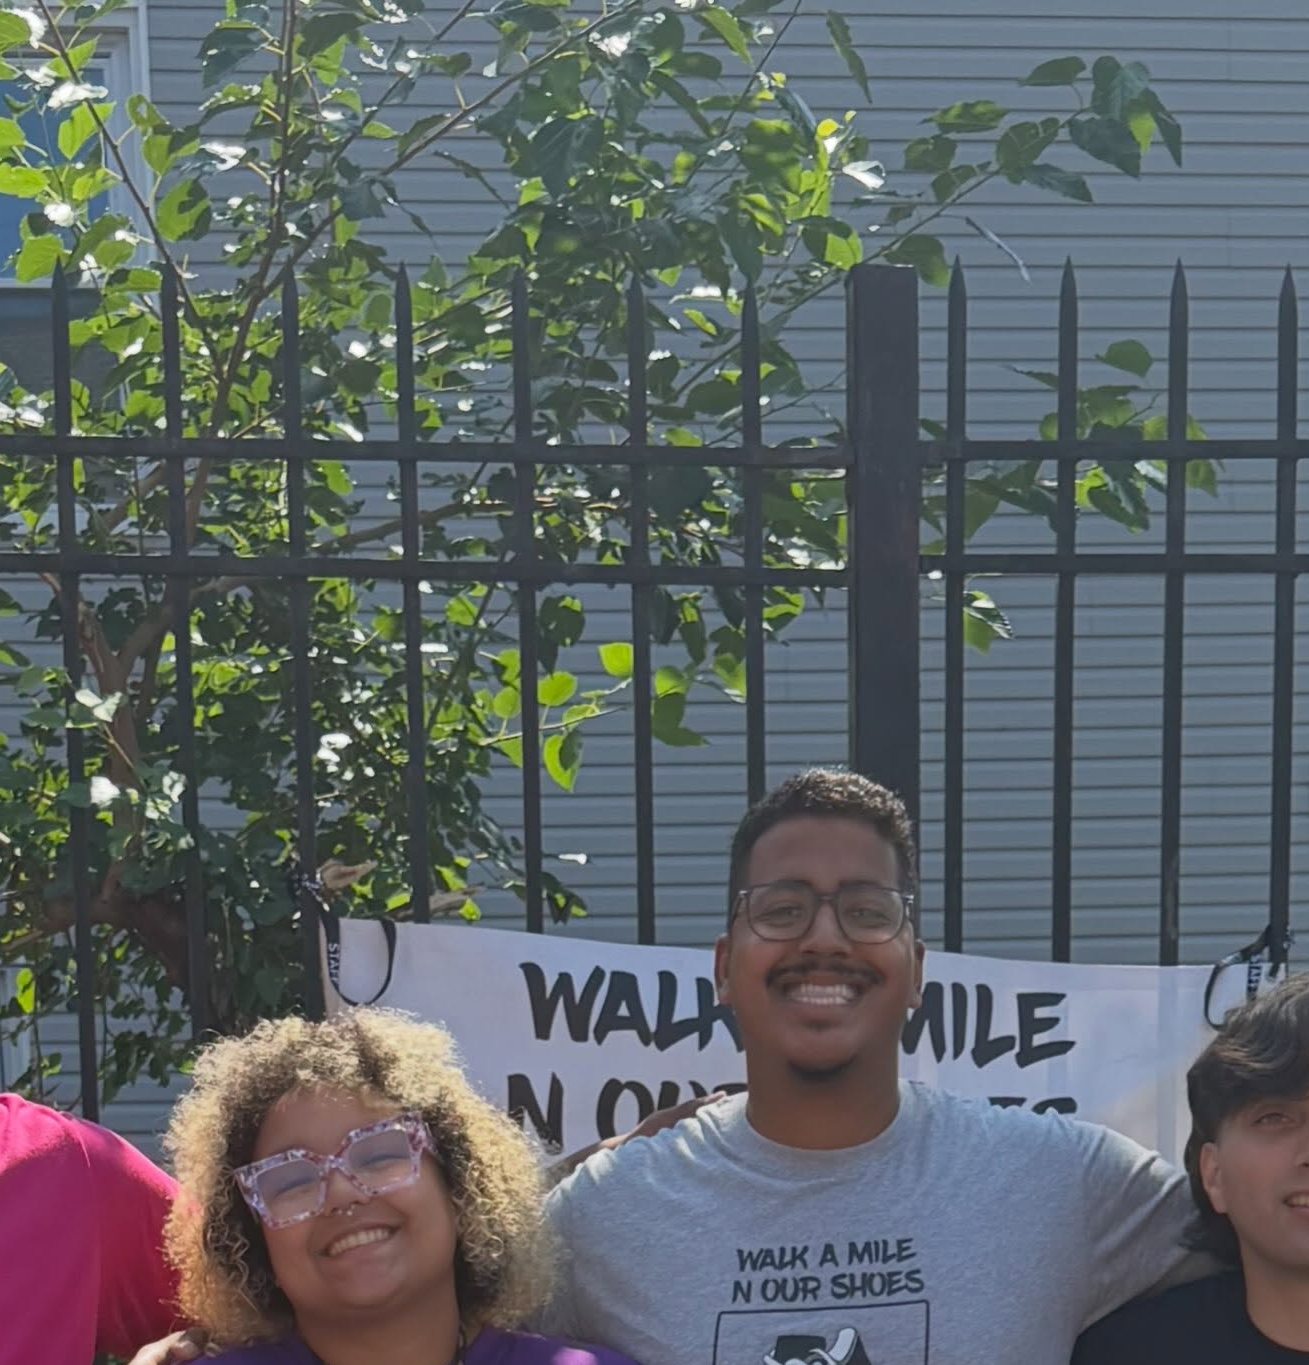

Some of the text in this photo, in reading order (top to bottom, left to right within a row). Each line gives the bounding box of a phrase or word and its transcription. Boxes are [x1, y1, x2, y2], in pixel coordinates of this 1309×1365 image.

[736, 1238, 917, 1273] WALK A MILE
[731, 1268, 925, 1304] N OUR SHOES
